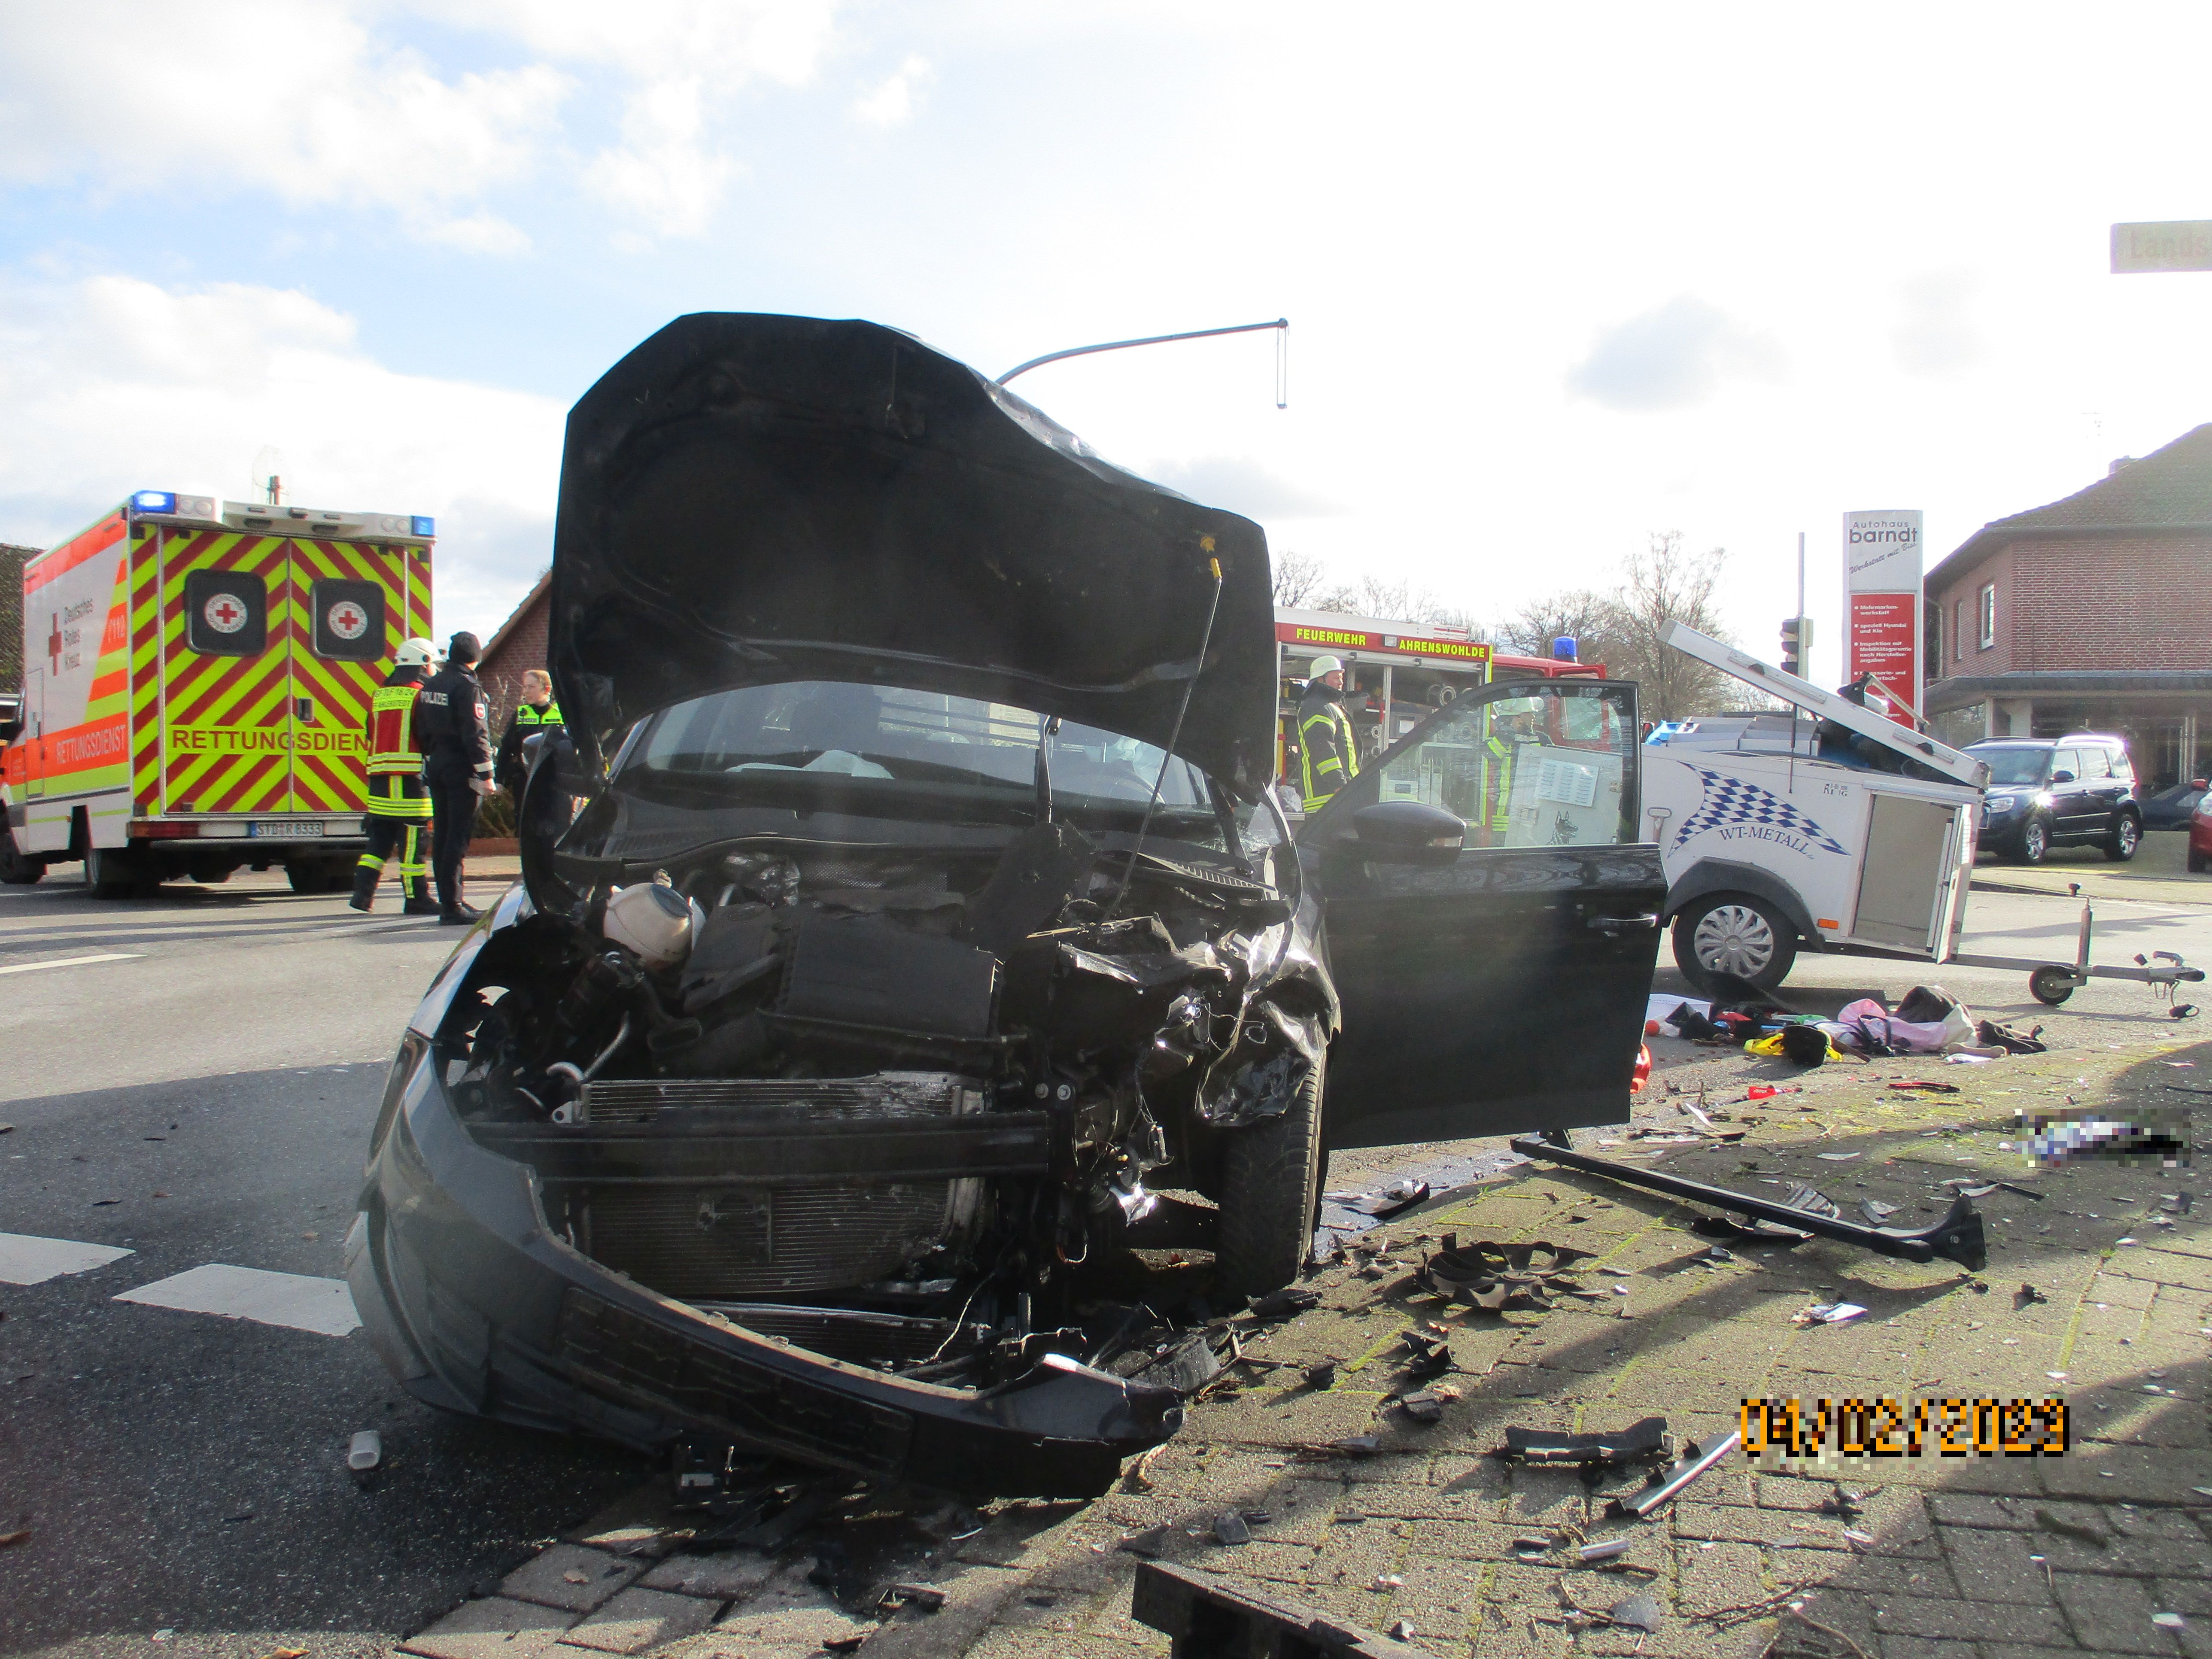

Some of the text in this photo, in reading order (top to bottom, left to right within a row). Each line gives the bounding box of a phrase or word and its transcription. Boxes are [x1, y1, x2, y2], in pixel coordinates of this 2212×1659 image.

[1849, 528, 1917, 544] barndt
[1849, 554, 1885, 574] Werkstatt
[1887, 548, 1899, 558] mit
[1296, 628, 1485, 658] FEUERWEHR AHRENSWOHLDE
[420, 690, 448, 706] POLIZEI
[56, 724, 126, 765] RETTUNGSDIENST
